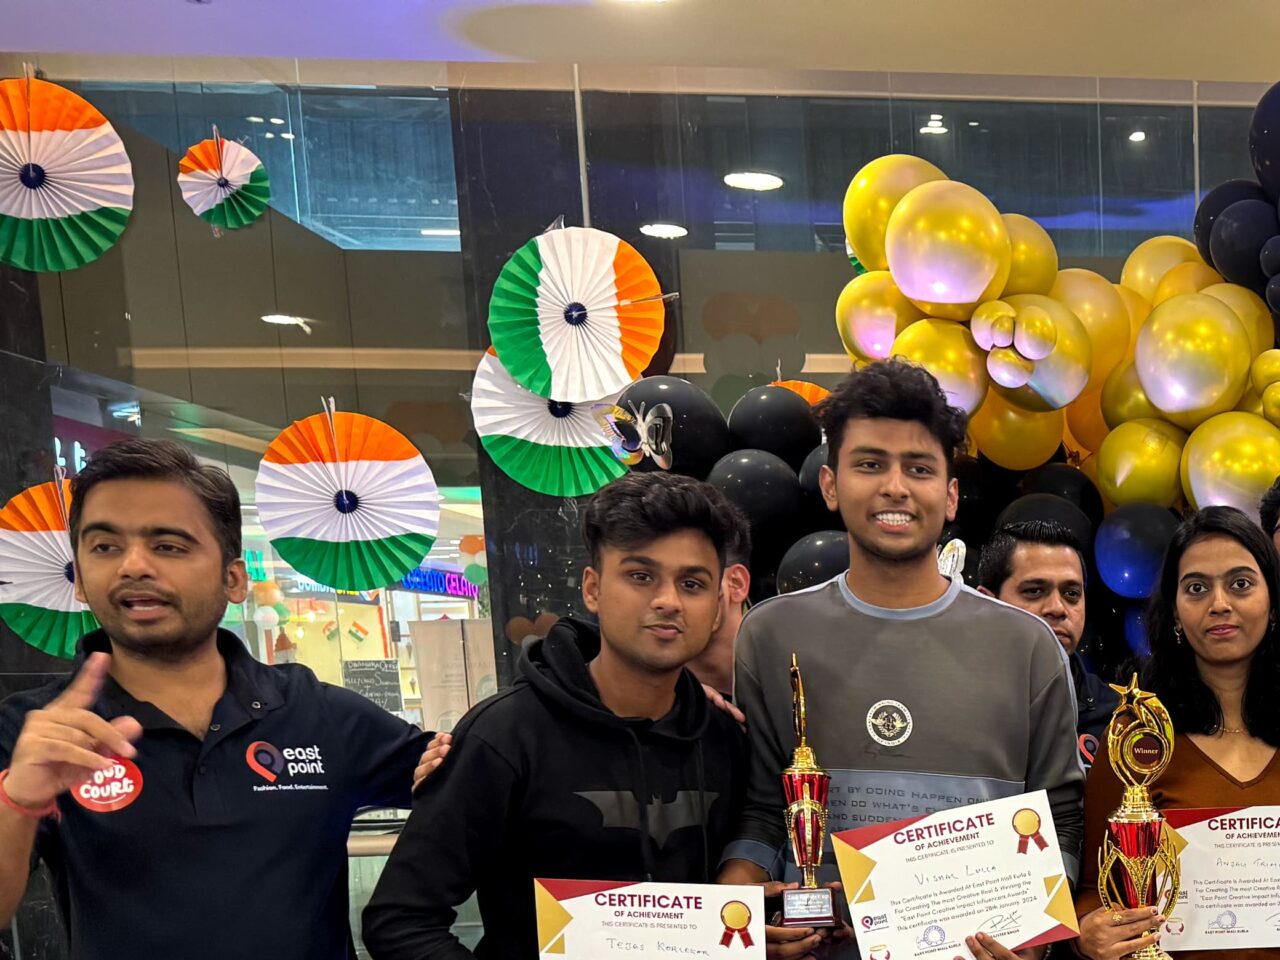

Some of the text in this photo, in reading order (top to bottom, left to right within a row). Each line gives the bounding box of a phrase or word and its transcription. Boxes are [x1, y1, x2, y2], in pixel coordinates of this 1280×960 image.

[283, 745, 322, 760] east
[288, 760, 325, 776] point
[848, 787, 861, 795] BY
[866, 787, 906, 797] DOING
[912, 791, 962, 804] HAPPEN
[894, 813, 994, 844] CERTIFICATE
[915, 832, 980, 851] OF ACHIEVEMENT
[917, 848, 949, 860] CERTIFICATE
[956, 841, 985, 852] PRESENTED
[594, 893, 701, 909] CERTIFICATE
[627, 911, 684, 919] ACHIEVEMENT
